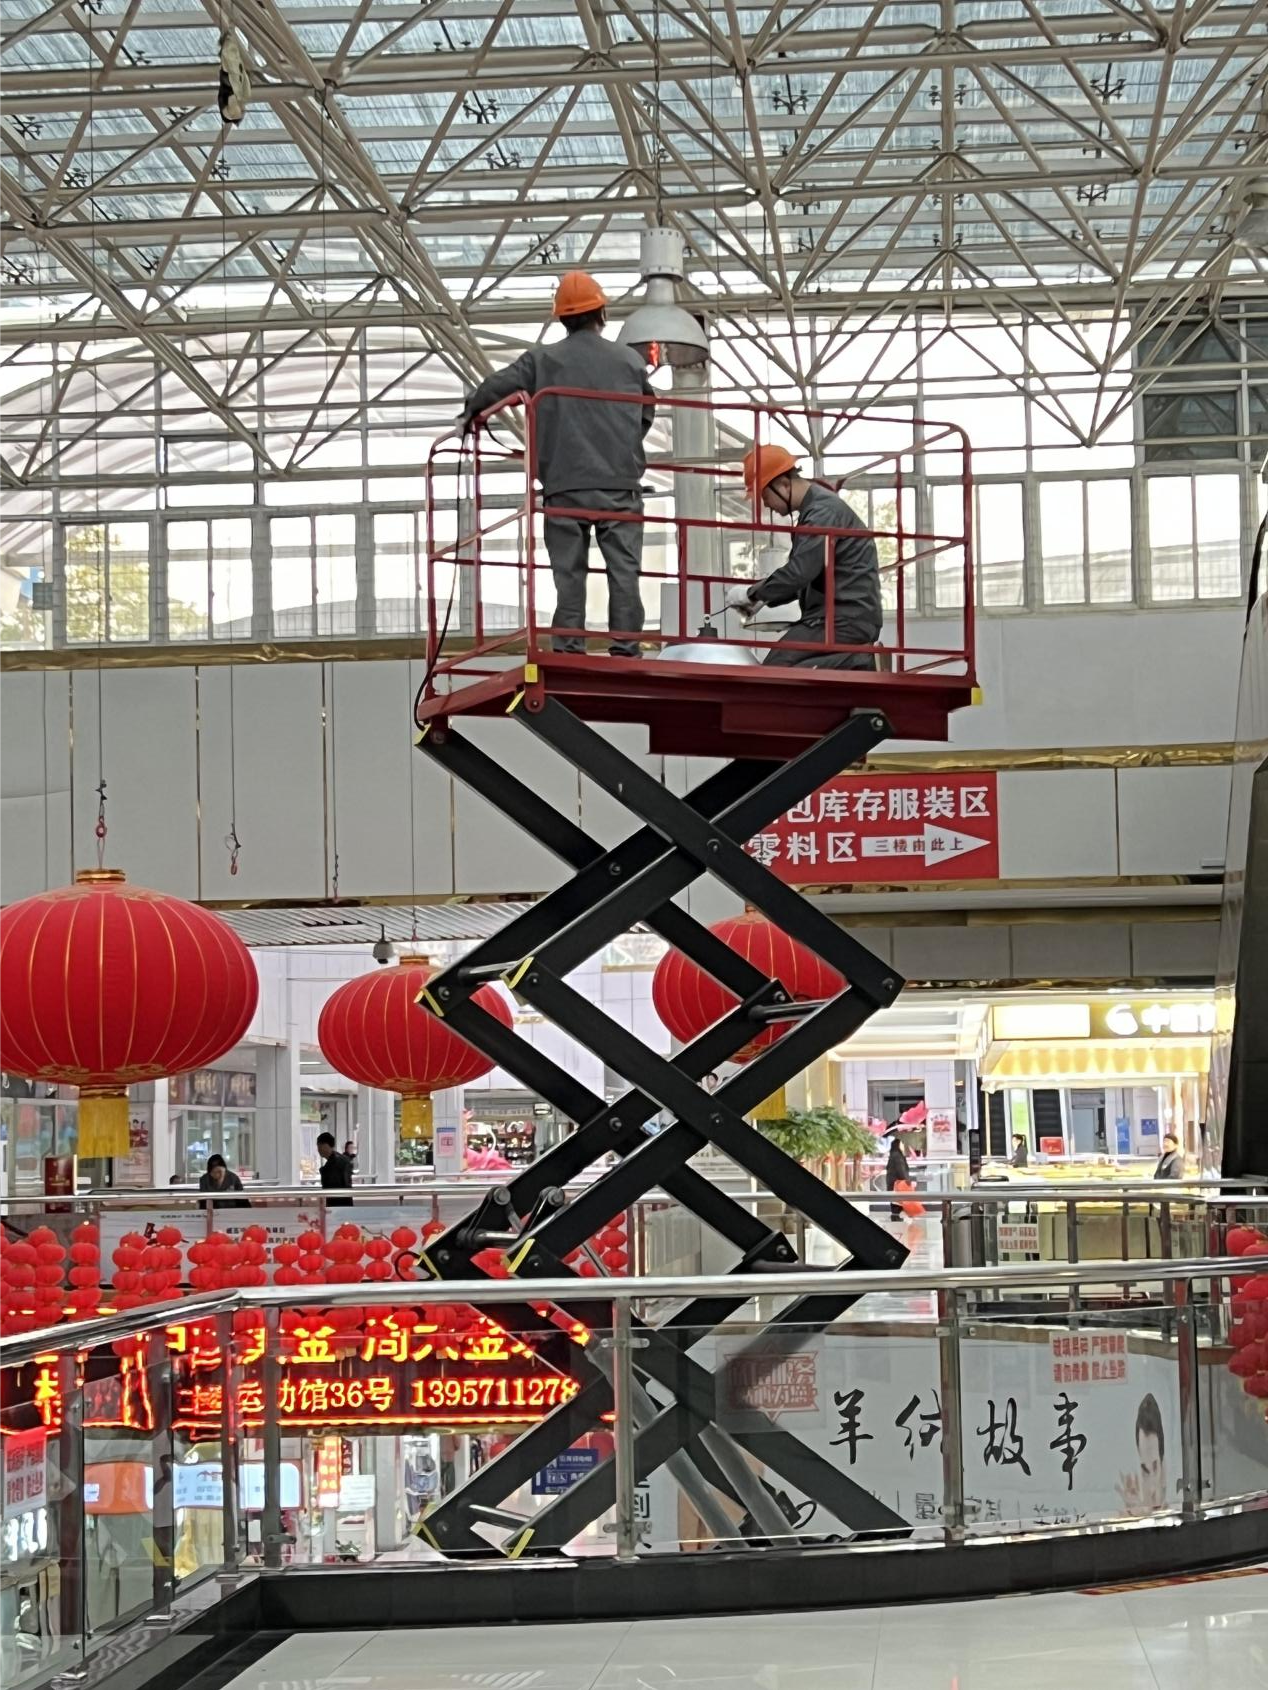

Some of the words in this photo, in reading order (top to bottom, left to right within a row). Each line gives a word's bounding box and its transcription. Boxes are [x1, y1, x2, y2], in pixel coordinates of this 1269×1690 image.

[772, 786, 989, 823] 包库存服装区
[741, 831, 858, 867] 零料区
[875, 836, 964, 854] 三楼由此上
